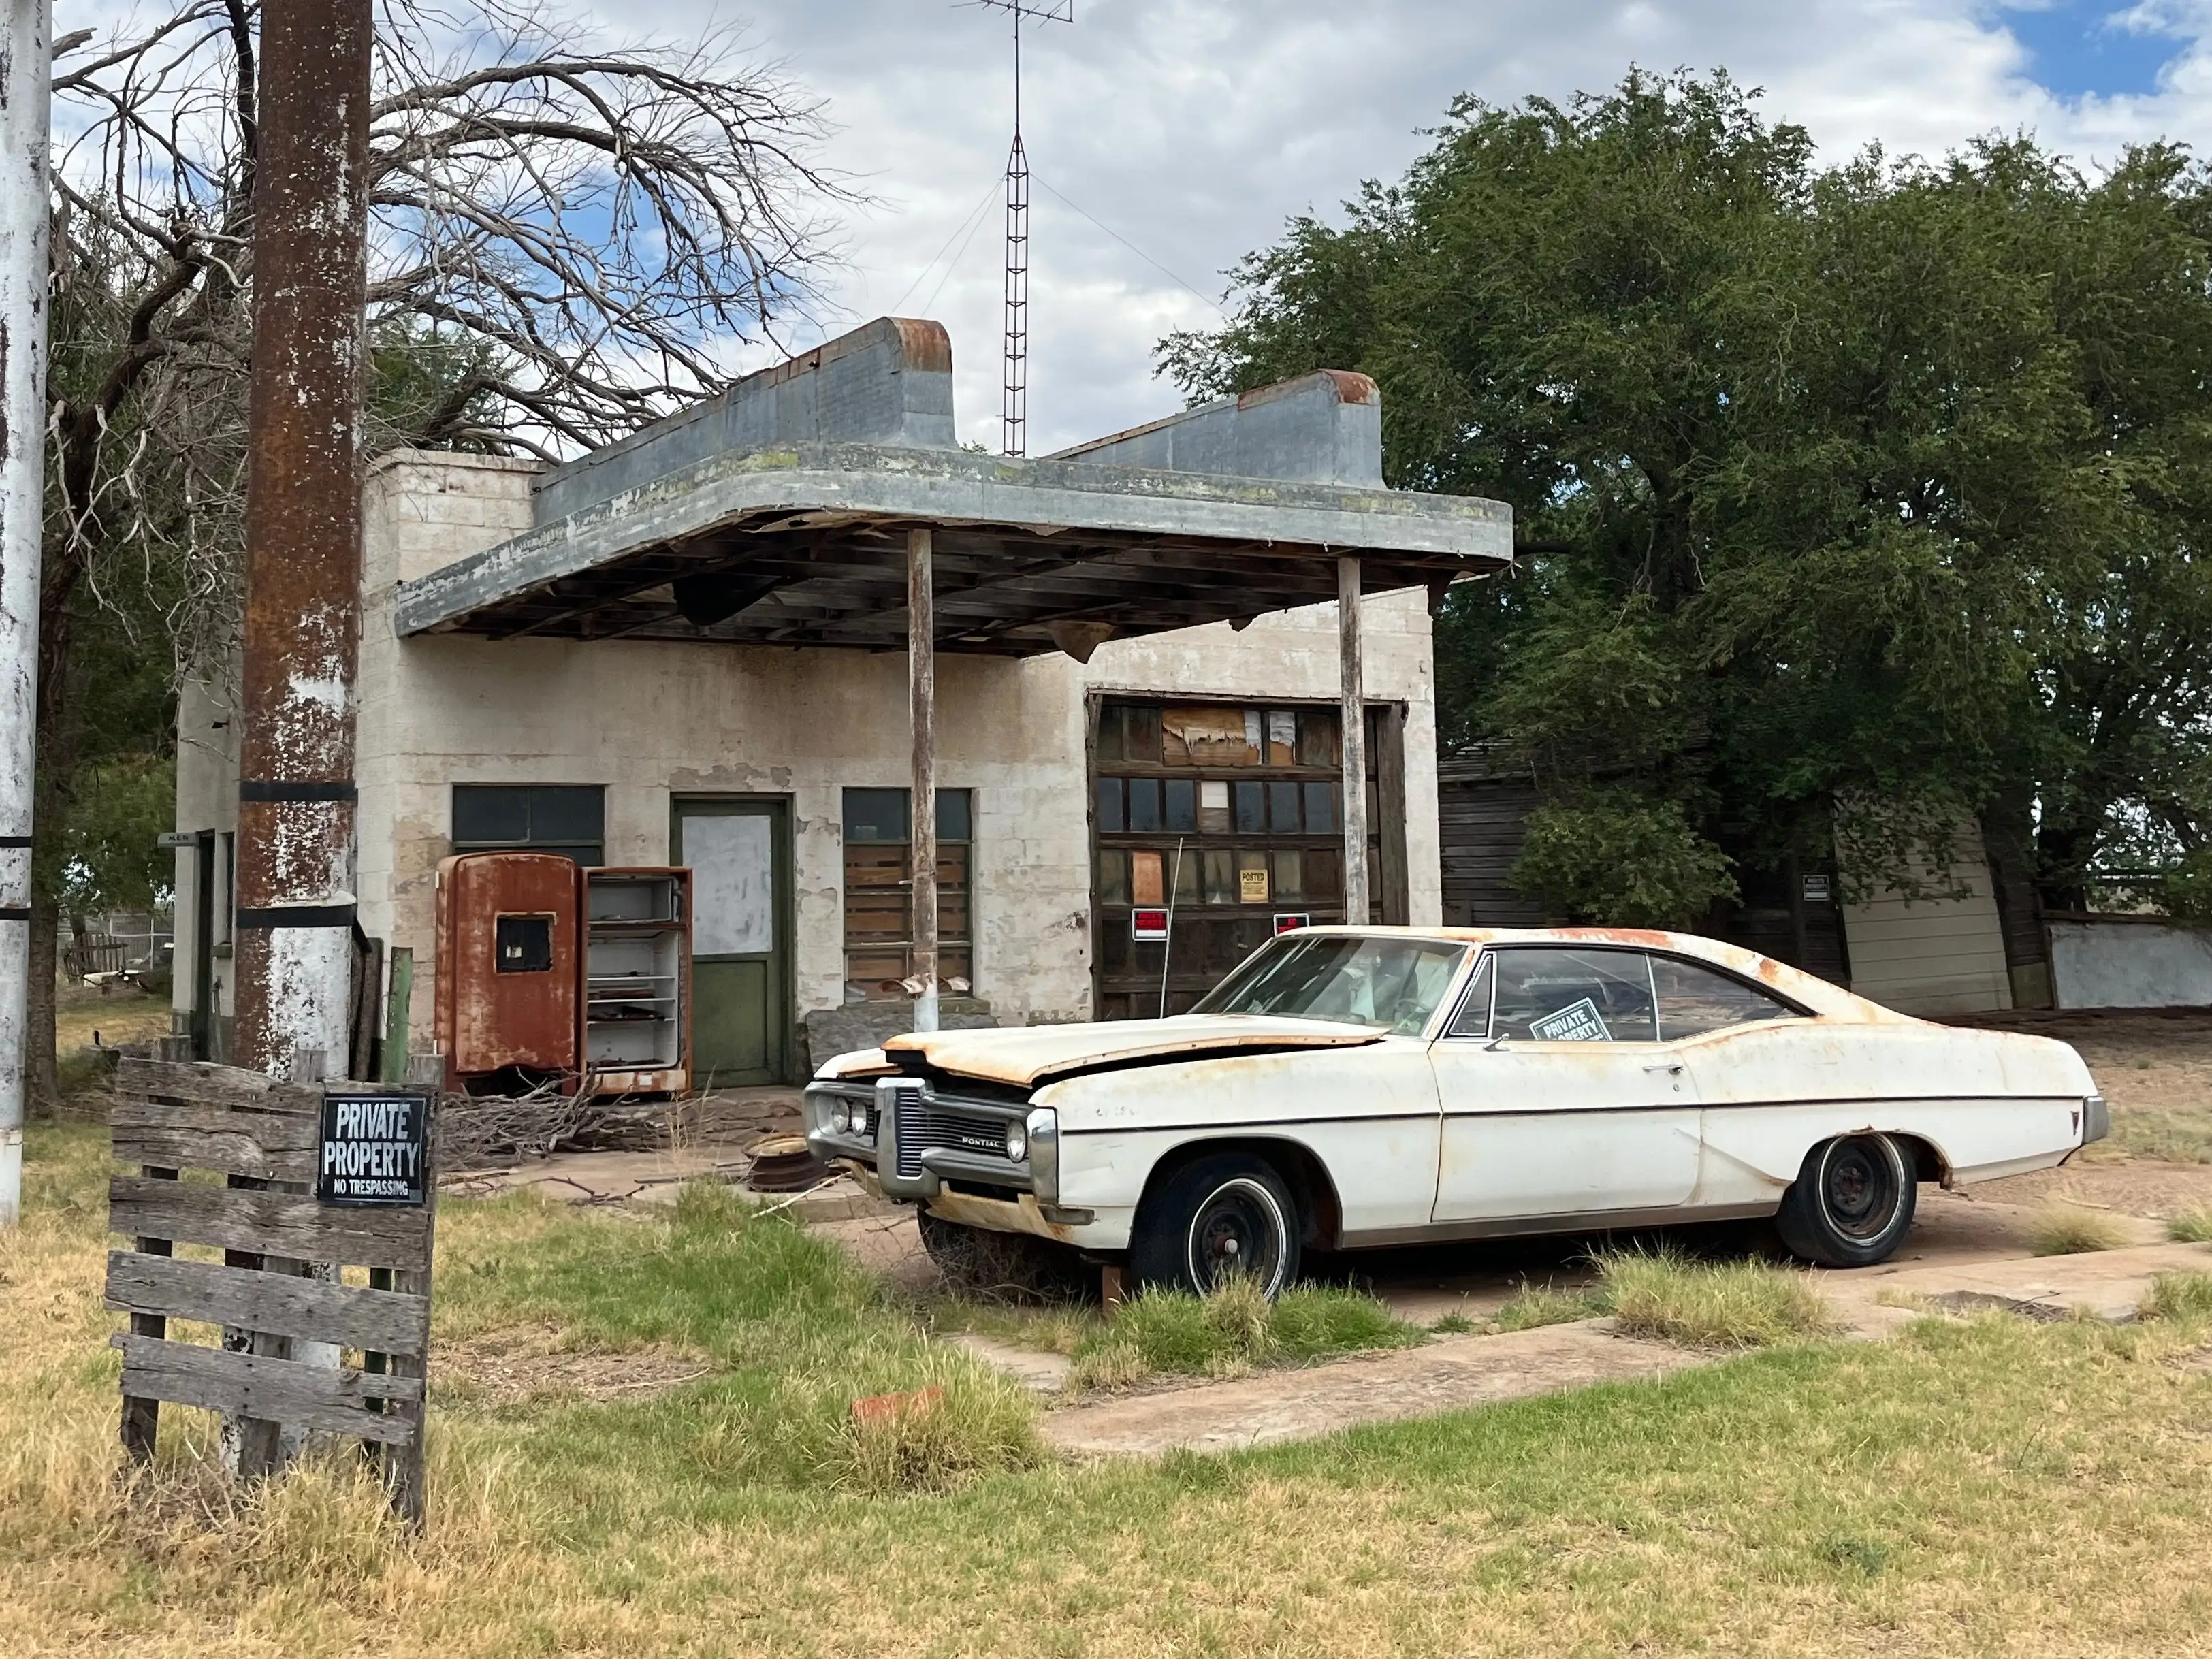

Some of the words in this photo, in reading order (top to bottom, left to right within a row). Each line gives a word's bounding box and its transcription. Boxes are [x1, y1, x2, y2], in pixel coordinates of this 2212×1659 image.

[1543, 1009, 1588, 1039] PRIVATE
[1554, 1020, 1599, 1041] PERTY
[336, 1103, 411, 1140] PRIVATE
[962, 1137, 1000, 1148] PONTIAC
[324, 1140, 419, 1177] PROPERTY
[334, 1178, 347, 1194] NO
[349, 1179, 408, 1196] TRESPASSING
